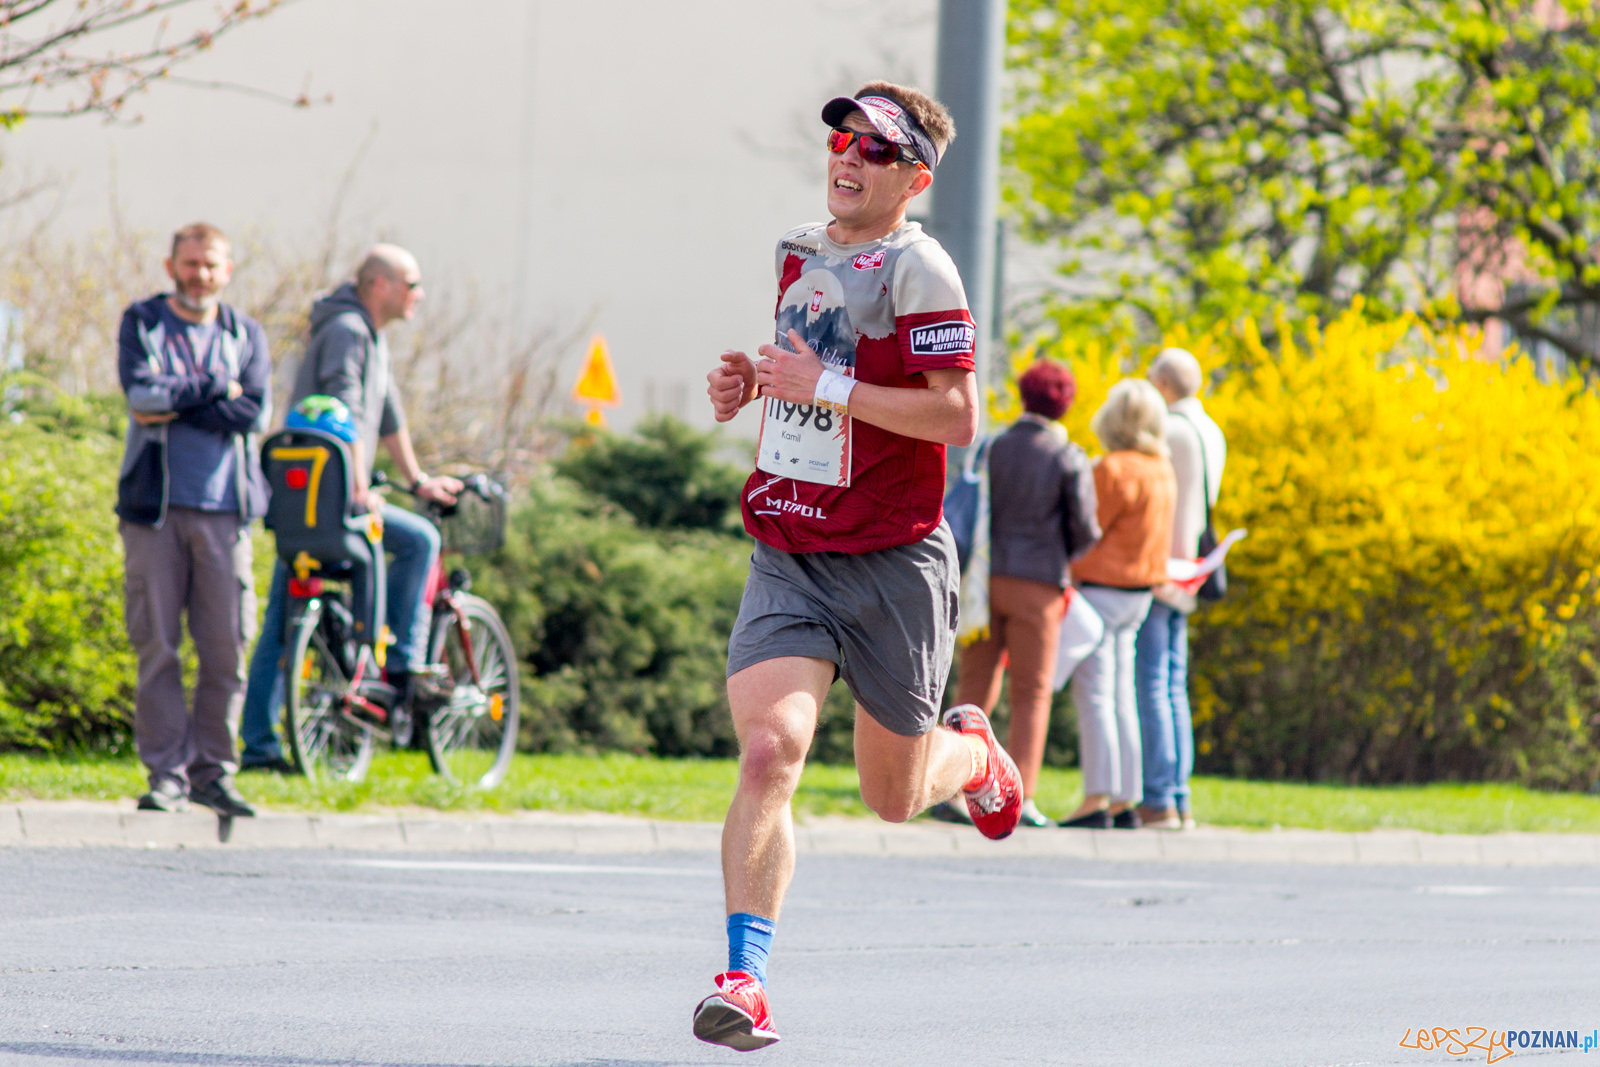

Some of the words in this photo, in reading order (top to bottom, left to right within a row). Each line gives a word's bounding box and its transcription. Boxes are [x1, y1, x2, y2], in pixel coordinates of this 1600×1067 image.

[781, 241, 817, 257] BODYWORK
[915, 326, 974, 346] HAMME
[932, 341, 971, 352] NUTRITION
[781, 430, 802, 443] Kamil
[765, 496, 828, 520] METPOL
